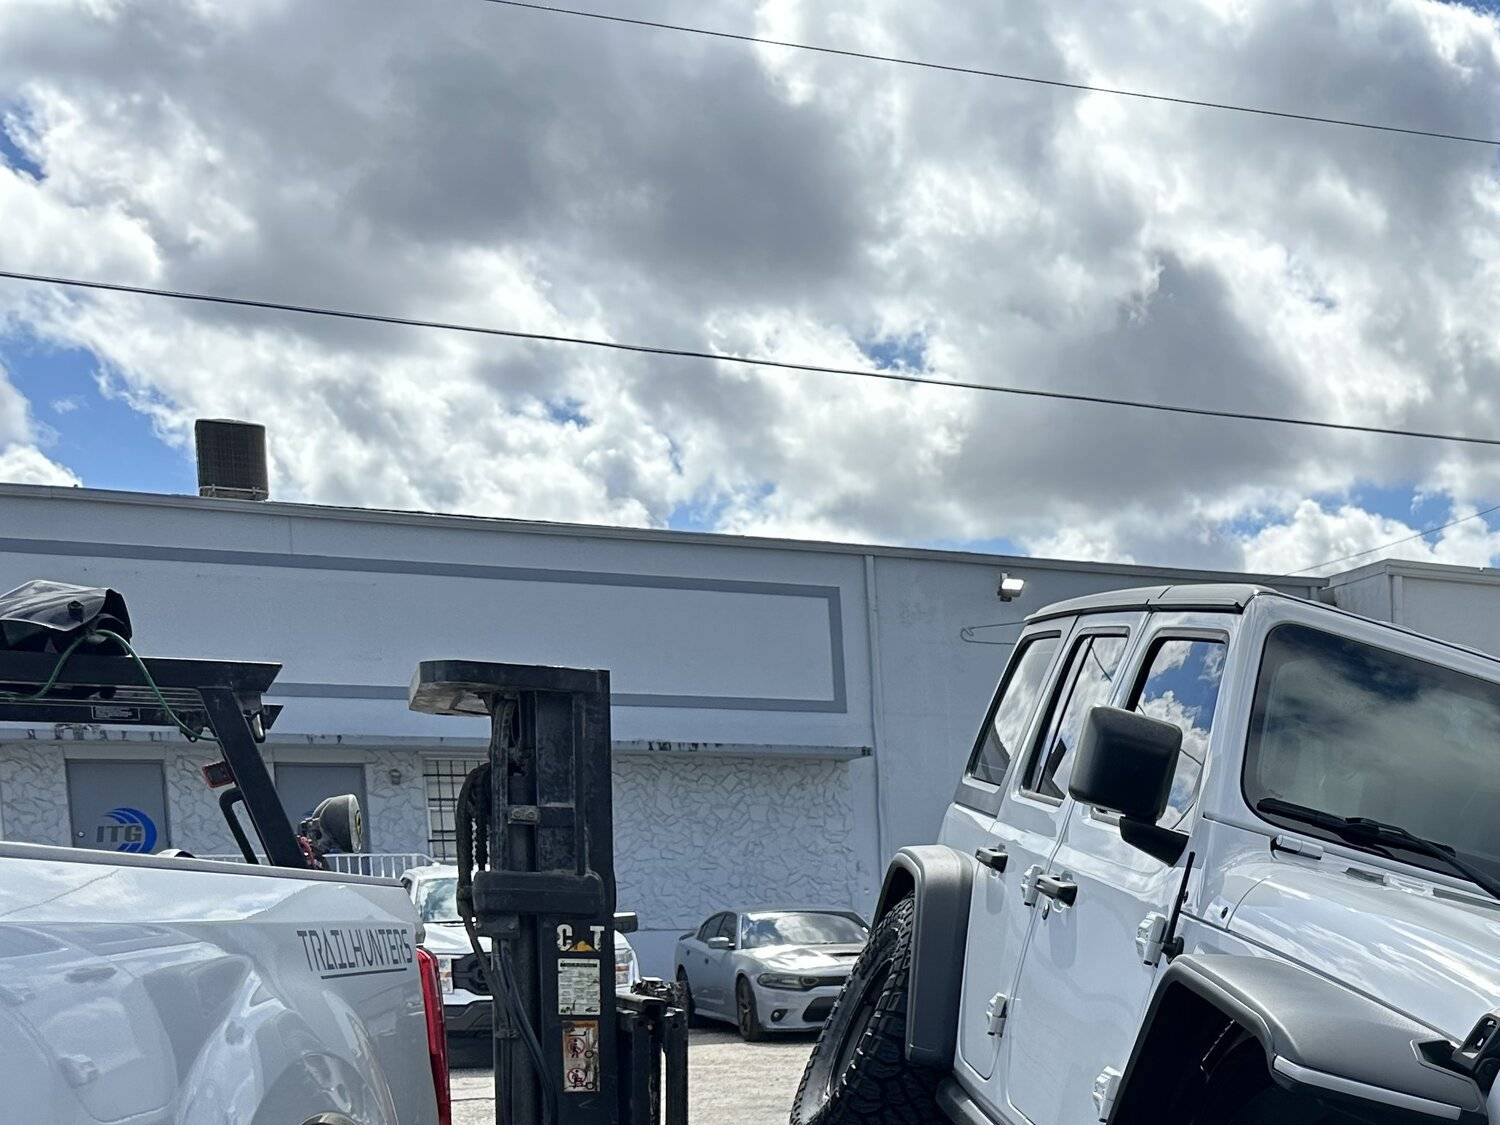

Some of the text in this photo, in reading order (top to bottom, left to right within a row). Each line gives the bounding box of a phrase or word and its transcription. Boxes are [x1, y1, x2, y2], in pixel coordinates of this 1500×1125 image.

[96, 825, 143, 843] ITG
[296, 928, 413, 972] TRAILHUNTERS
[556, 923, 605, 952] CT
